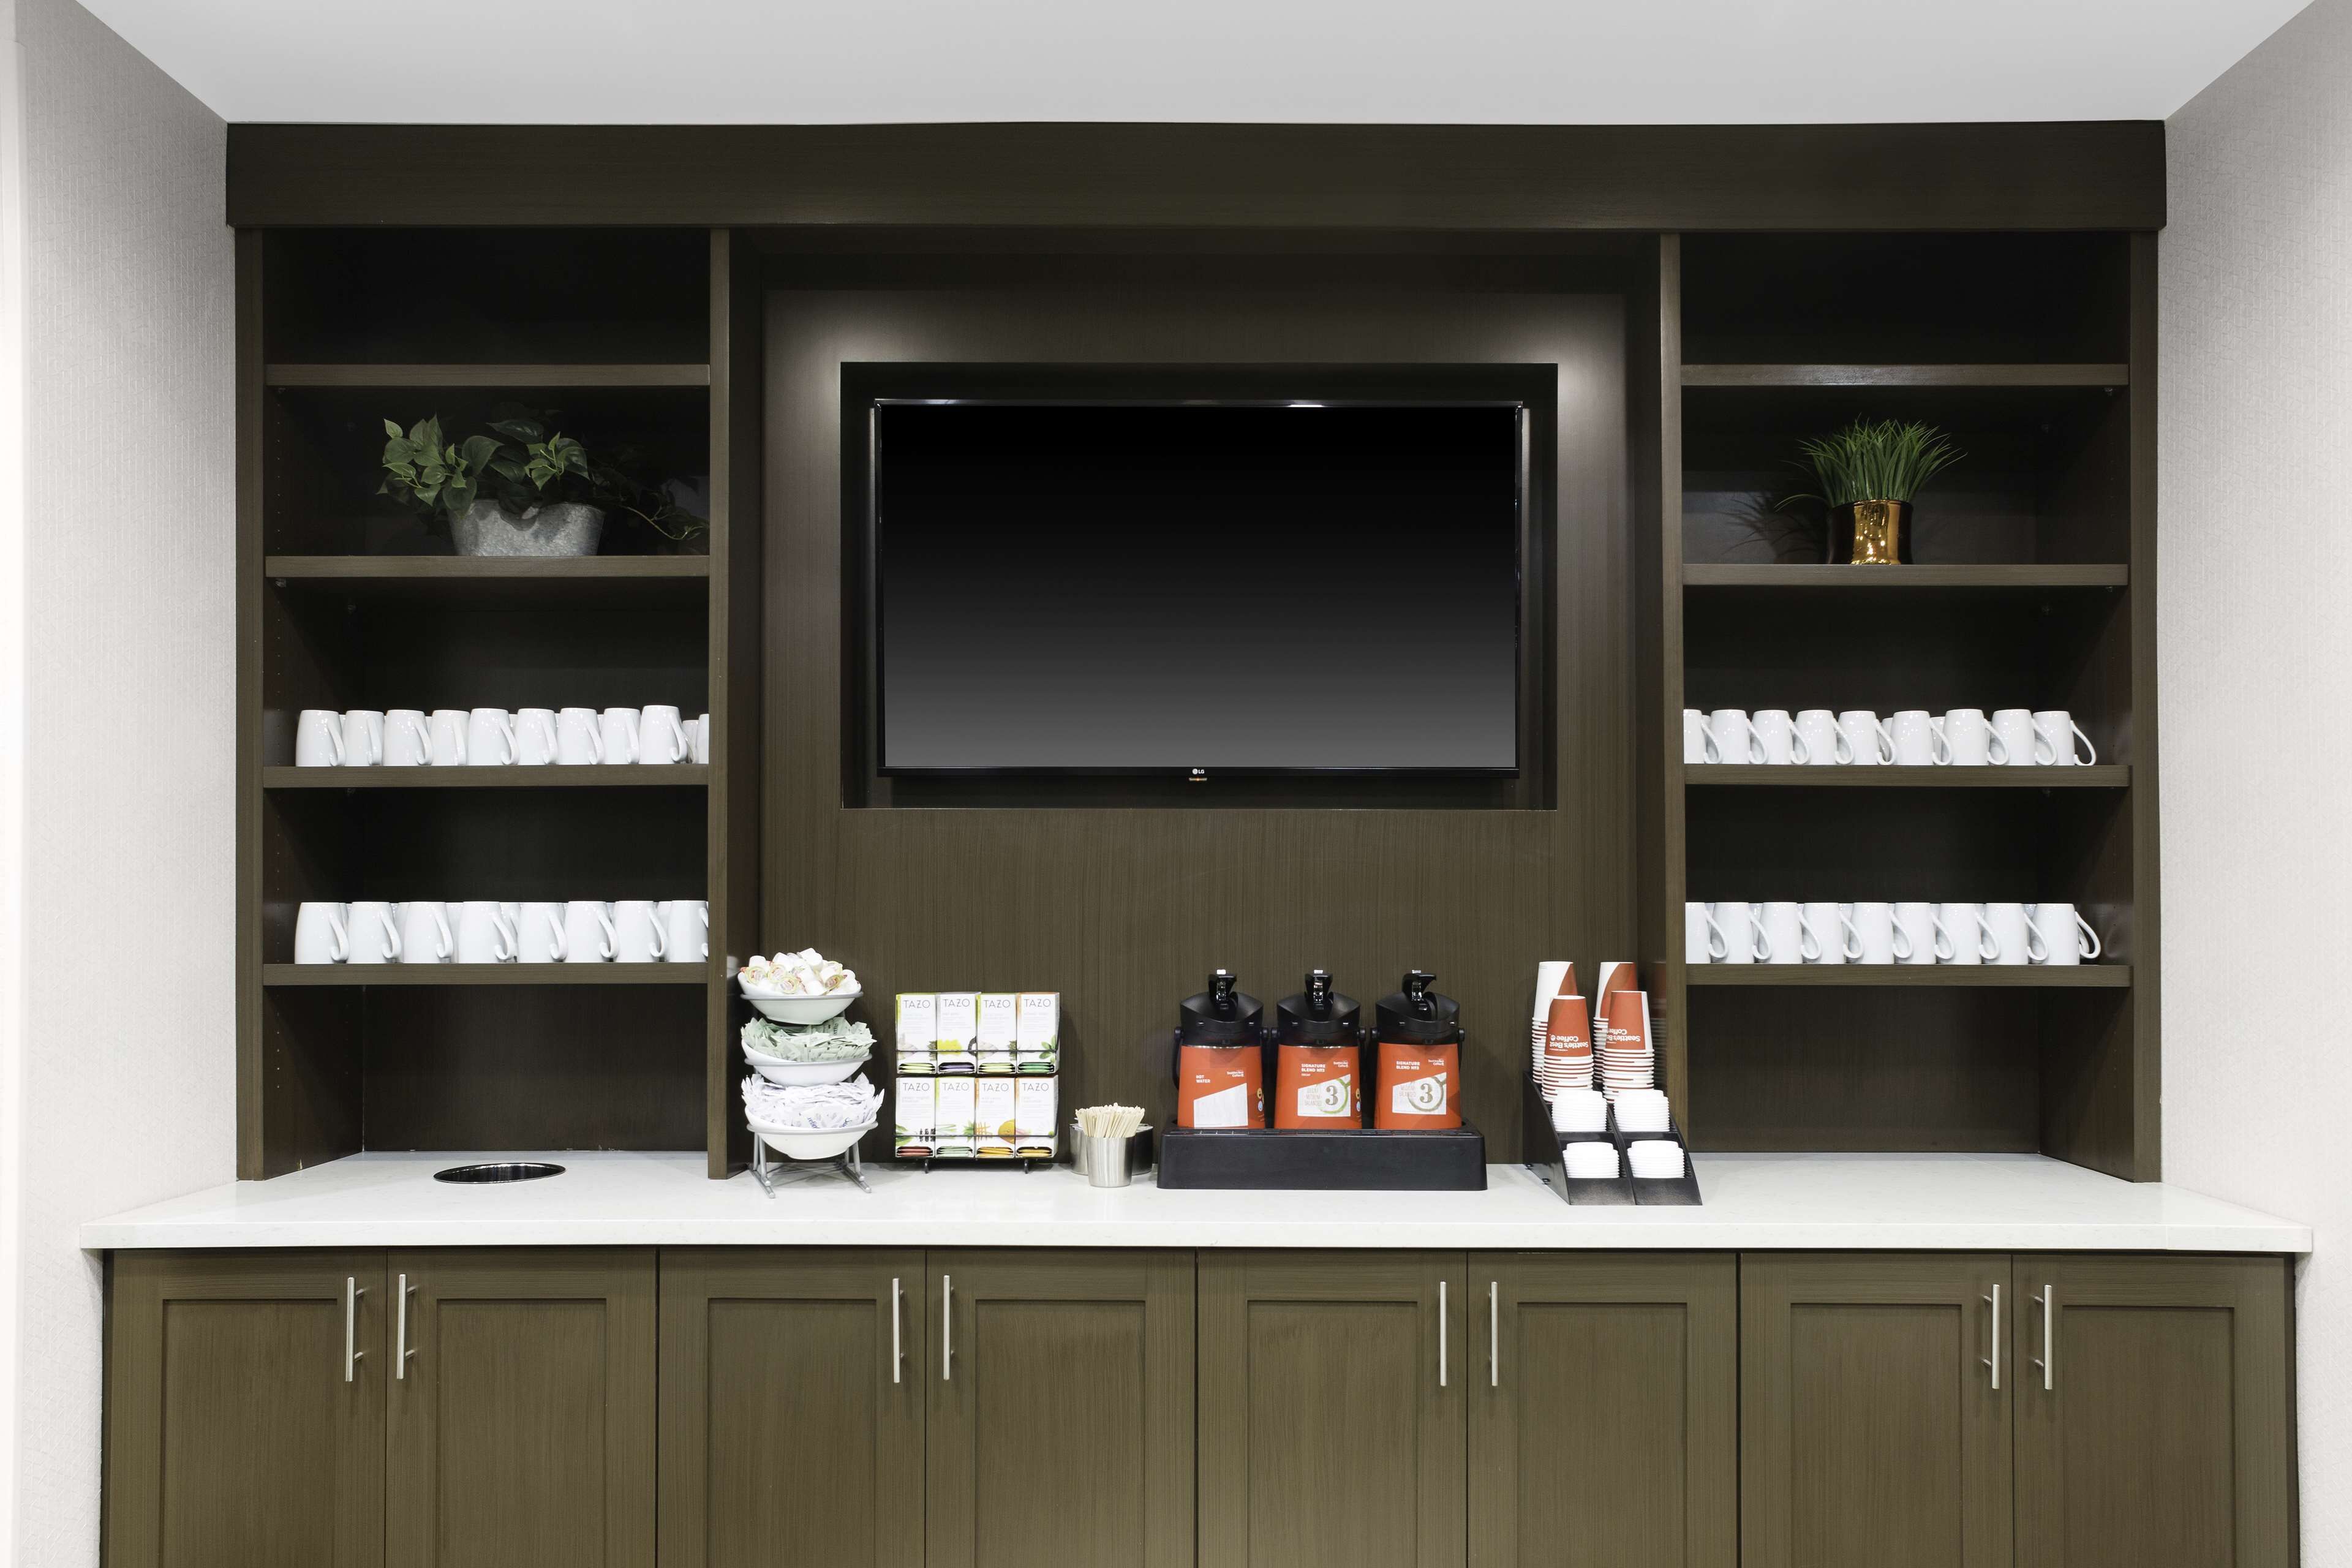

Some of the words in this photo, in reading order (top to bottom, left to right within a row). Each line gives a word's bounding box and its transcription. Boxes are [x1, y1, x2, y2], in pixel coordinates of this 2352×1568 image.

[903, 1000, 931, 1009] TAZO
[943, 998, 970, 1008] TAZO
[983, 999, 1011, 1008] TAZO
[1023, 998, 1051, 1008] TAZO
[903, 1082, 930, 1091] TAZO
[942, 1082, 970, 1091] TAZO
[982, 1083, 1009, 1092] TAZO
[1022, 1082, 1049, 1091] TAZO
[1325, 1085, 1338, 1106] 3
[1419, 1083, 1433, 1103] 3
